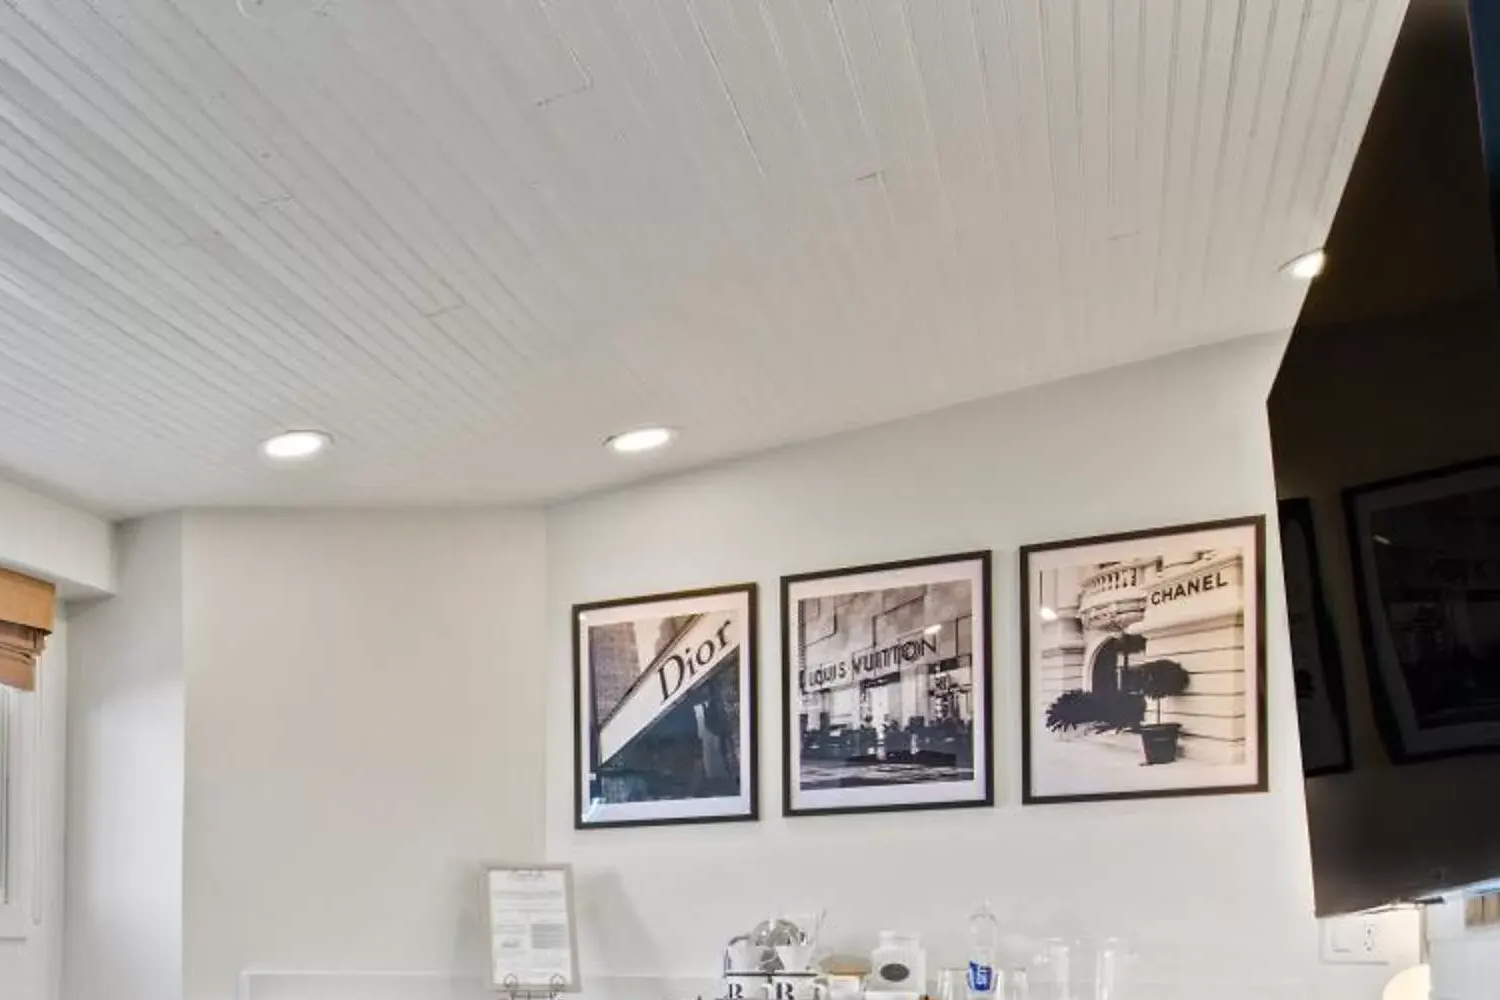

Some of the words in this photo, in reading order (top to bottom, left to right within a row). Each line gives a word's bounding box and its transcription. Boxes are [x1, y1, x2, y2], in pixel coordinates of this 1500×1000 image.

[1151, 572, 1228, 605] CHANEL
[658, 620, 731, 701] Dior
[809, 661, 846, 686] LOUIS
[851, 635, 937, 673] VUITTON
